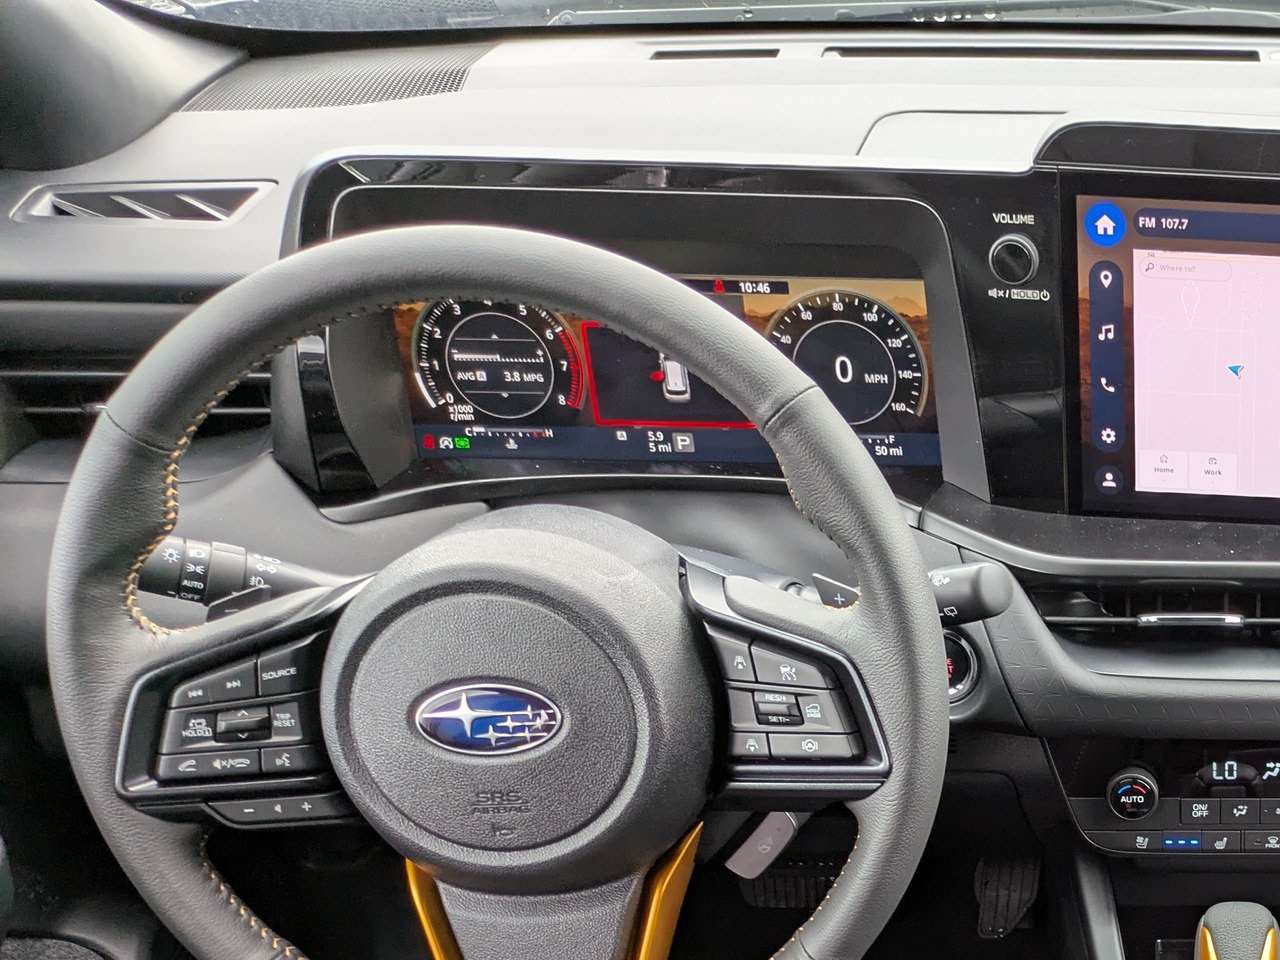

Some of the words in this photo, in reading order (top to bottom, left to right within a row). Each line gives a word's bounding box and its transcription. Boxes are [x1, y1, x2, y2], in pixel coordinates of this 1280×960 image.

[992, 213, 1034, 225] VOLUME
[1138, 216, 1156, 228] FM
[1161, 218, 1188, 230] 107.7
[739, 282, 770, 294] 10:46
[454, 304, 461, 316] 3
[520, 304, 527, 316] 5
[832, 302, 843, 312] 80
[802, 312, 812, 320] 60
[863, 313, 878, 322] 100
[434, 328, 442, 339] 2
[546, 330, 554, 340] 6
[780, 335, 791, 344] 40
[887, 339, 902, 348] 120
[434, 360, 440, 370] 1
[560, 362, 568, 372] 7
[834, 356, 853, 383] 0
[457, 371, 476, 381] AVG
[504, 371, 521, 382] 3.8
[524, 373, 544, 383] MPG
[865, 374, 888, 384] MPH
[898, 371, 912, 379] 140
[446, 393, 454, 403] 0
[558, 395, 566, 405] 8
[891, 403, 906, 412] 160
[648, 432, 664, 441] 5.9
[649, 442, 656, 453] 5
[658, 443, 672, 453] mi
[676, 436, 690, 450] P
[875, 446, 887, 456] 50
[889, 447, 903, 456] mi
[182, 580, 203, 589] AUTO
[262, 667, 297, 680] SOURCE
